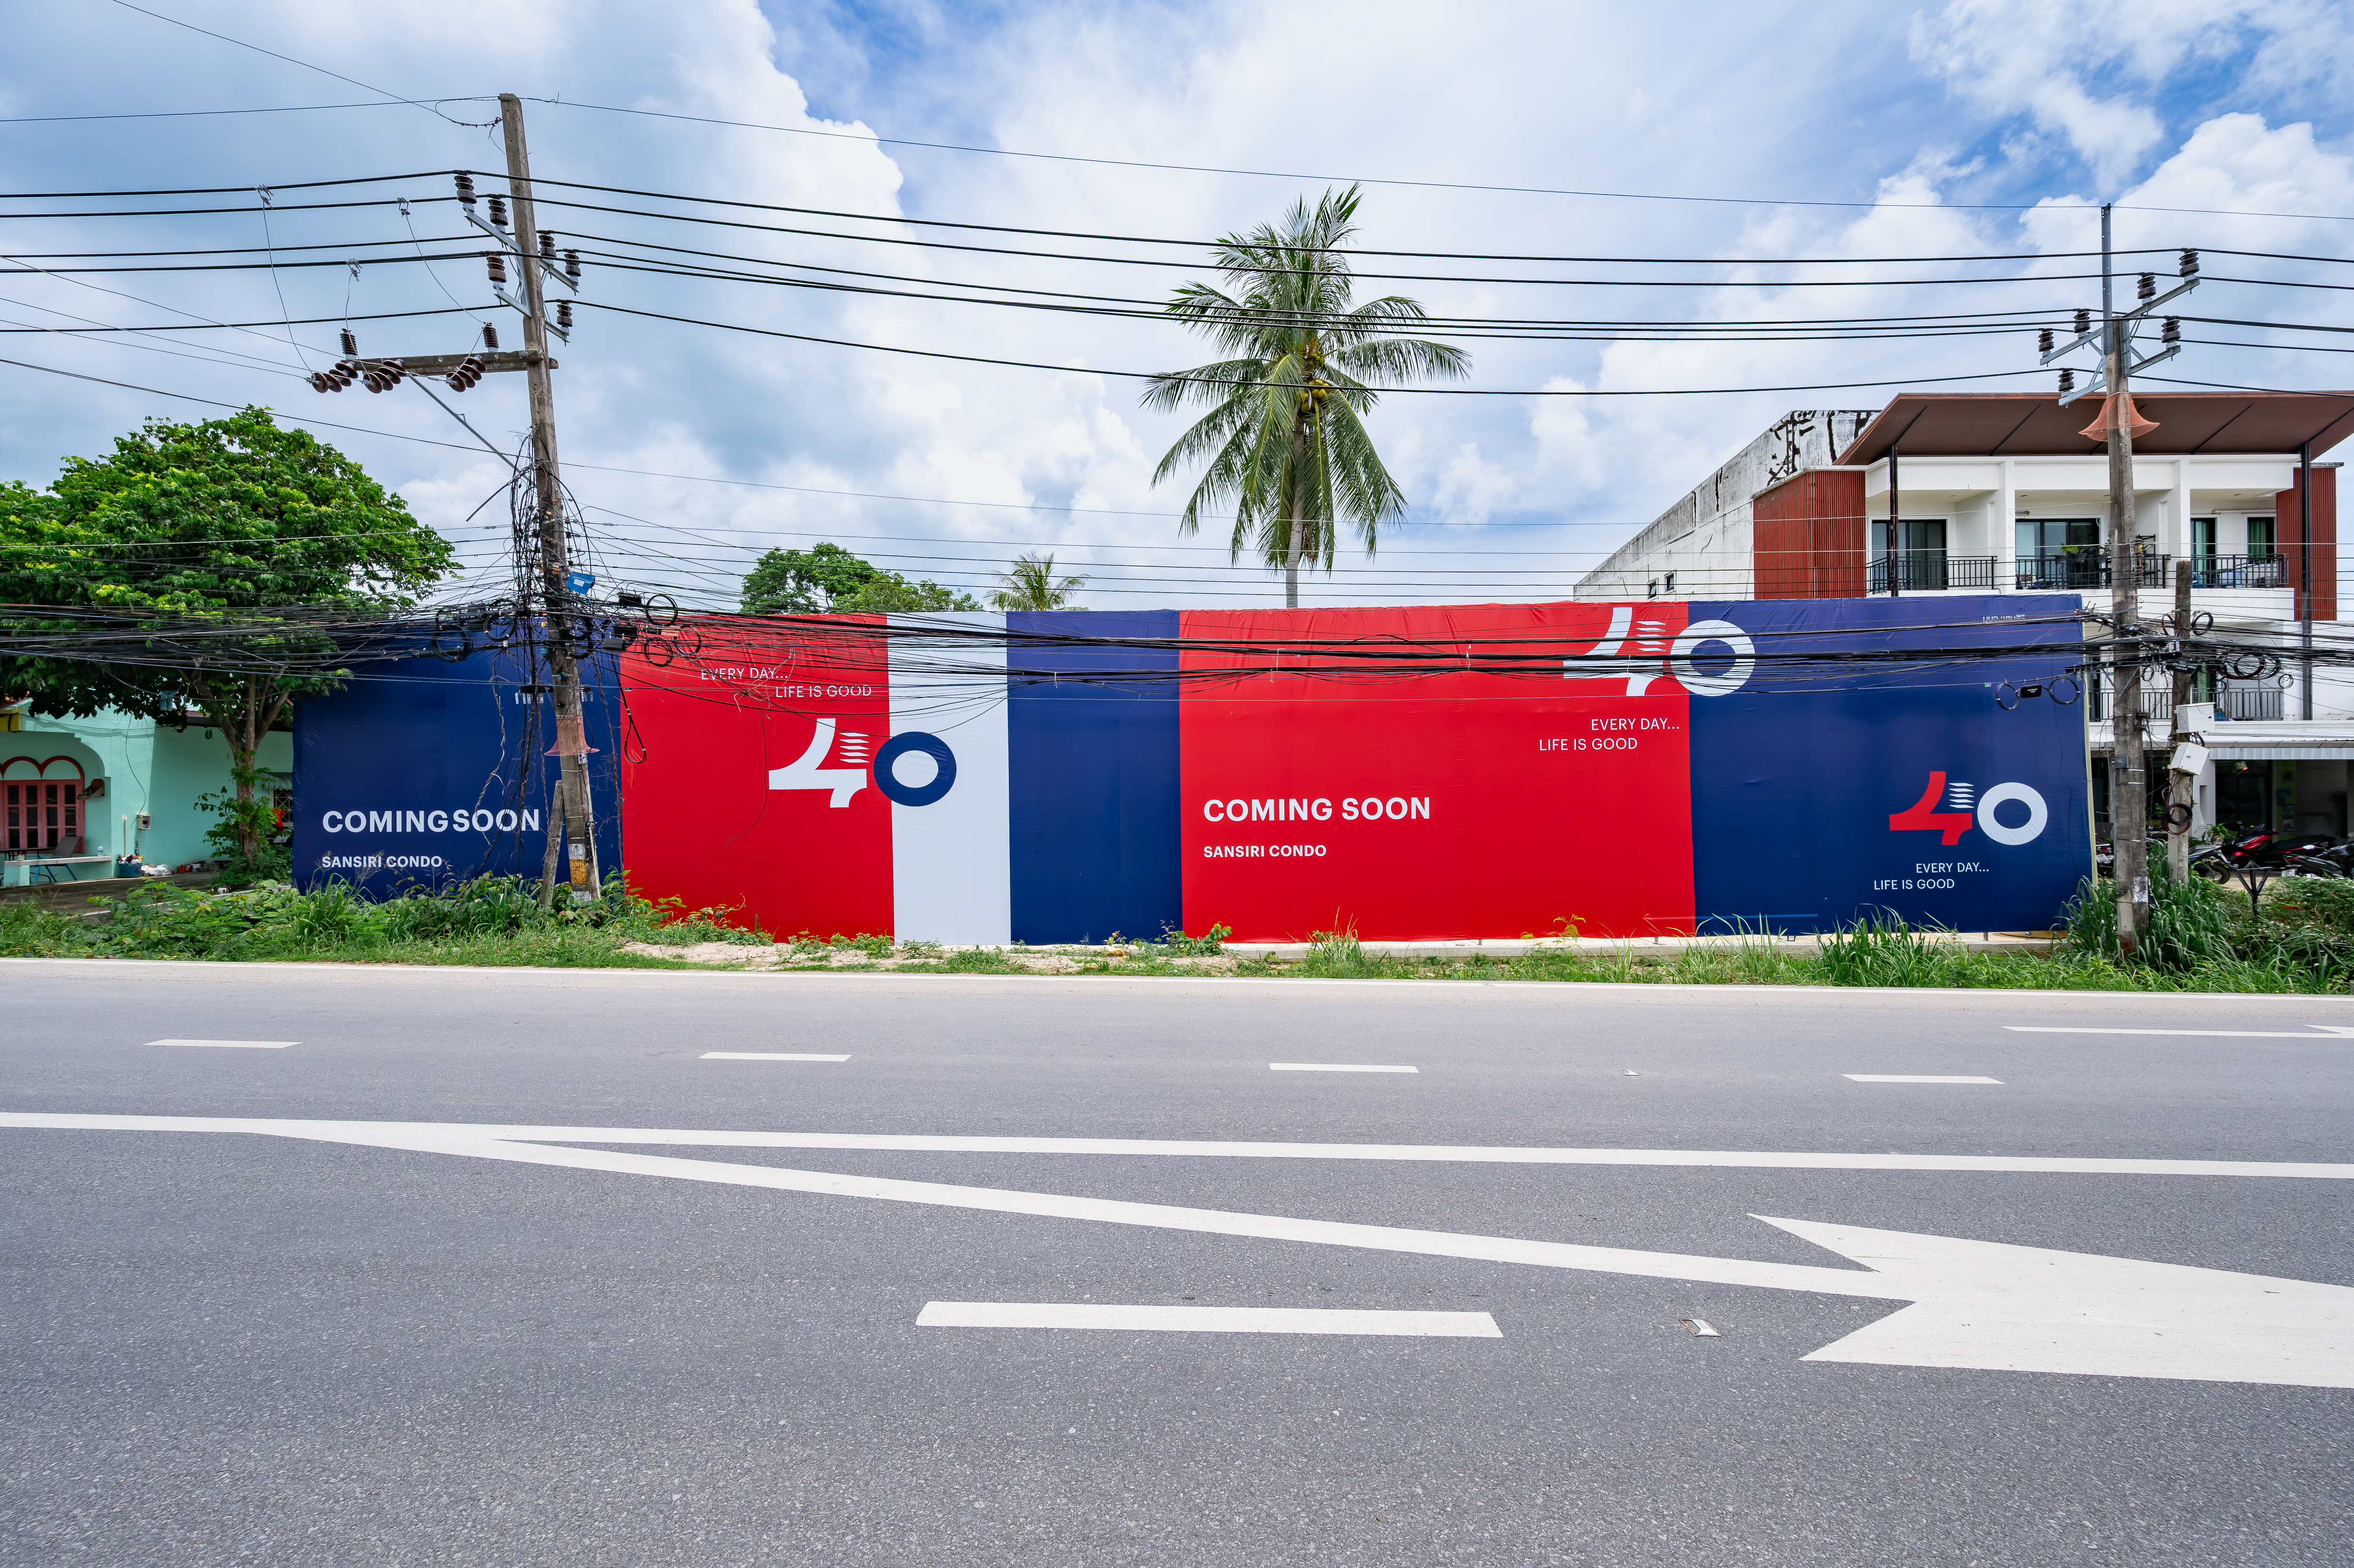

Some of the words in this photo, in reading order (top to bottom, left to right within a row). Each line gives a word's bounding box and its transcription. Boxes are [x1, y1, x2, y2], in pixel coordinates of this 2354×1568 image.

[701, 667, 745, 680] EVERY
[775, 686, 804, 698] LIFE
[809, 685, 822, 698] IS
[826, 684, 872, 697] GOOD
[1591, 718, 1636, 731] EVERY
[1641, 717, 1680, 730] DAY...
[1539, 739, 1568, 751] LIFE
[1574, 738, 1587, 750] IS
[1592, 738, 1637, 750] GOOD
[1203, 798, 1332, 822] COMING
[1342, 797, 1430, 820] SOON
[1203, 845, 1265, 858] SANSIRI
[1269, 844, 1327, 857] CONDO
[322, 855, 381, 868] SANSIRI
[386, 855, 443, 868] CONDO
[1916, 863, 1953, 873] EVERY
[1958, 862, 1989, 872] DAY...
[1874, 880, 1898, 890] LIFE
[1902, 879, 1913, 889] IS
[1917, 879, 1954, 889] GOOD
